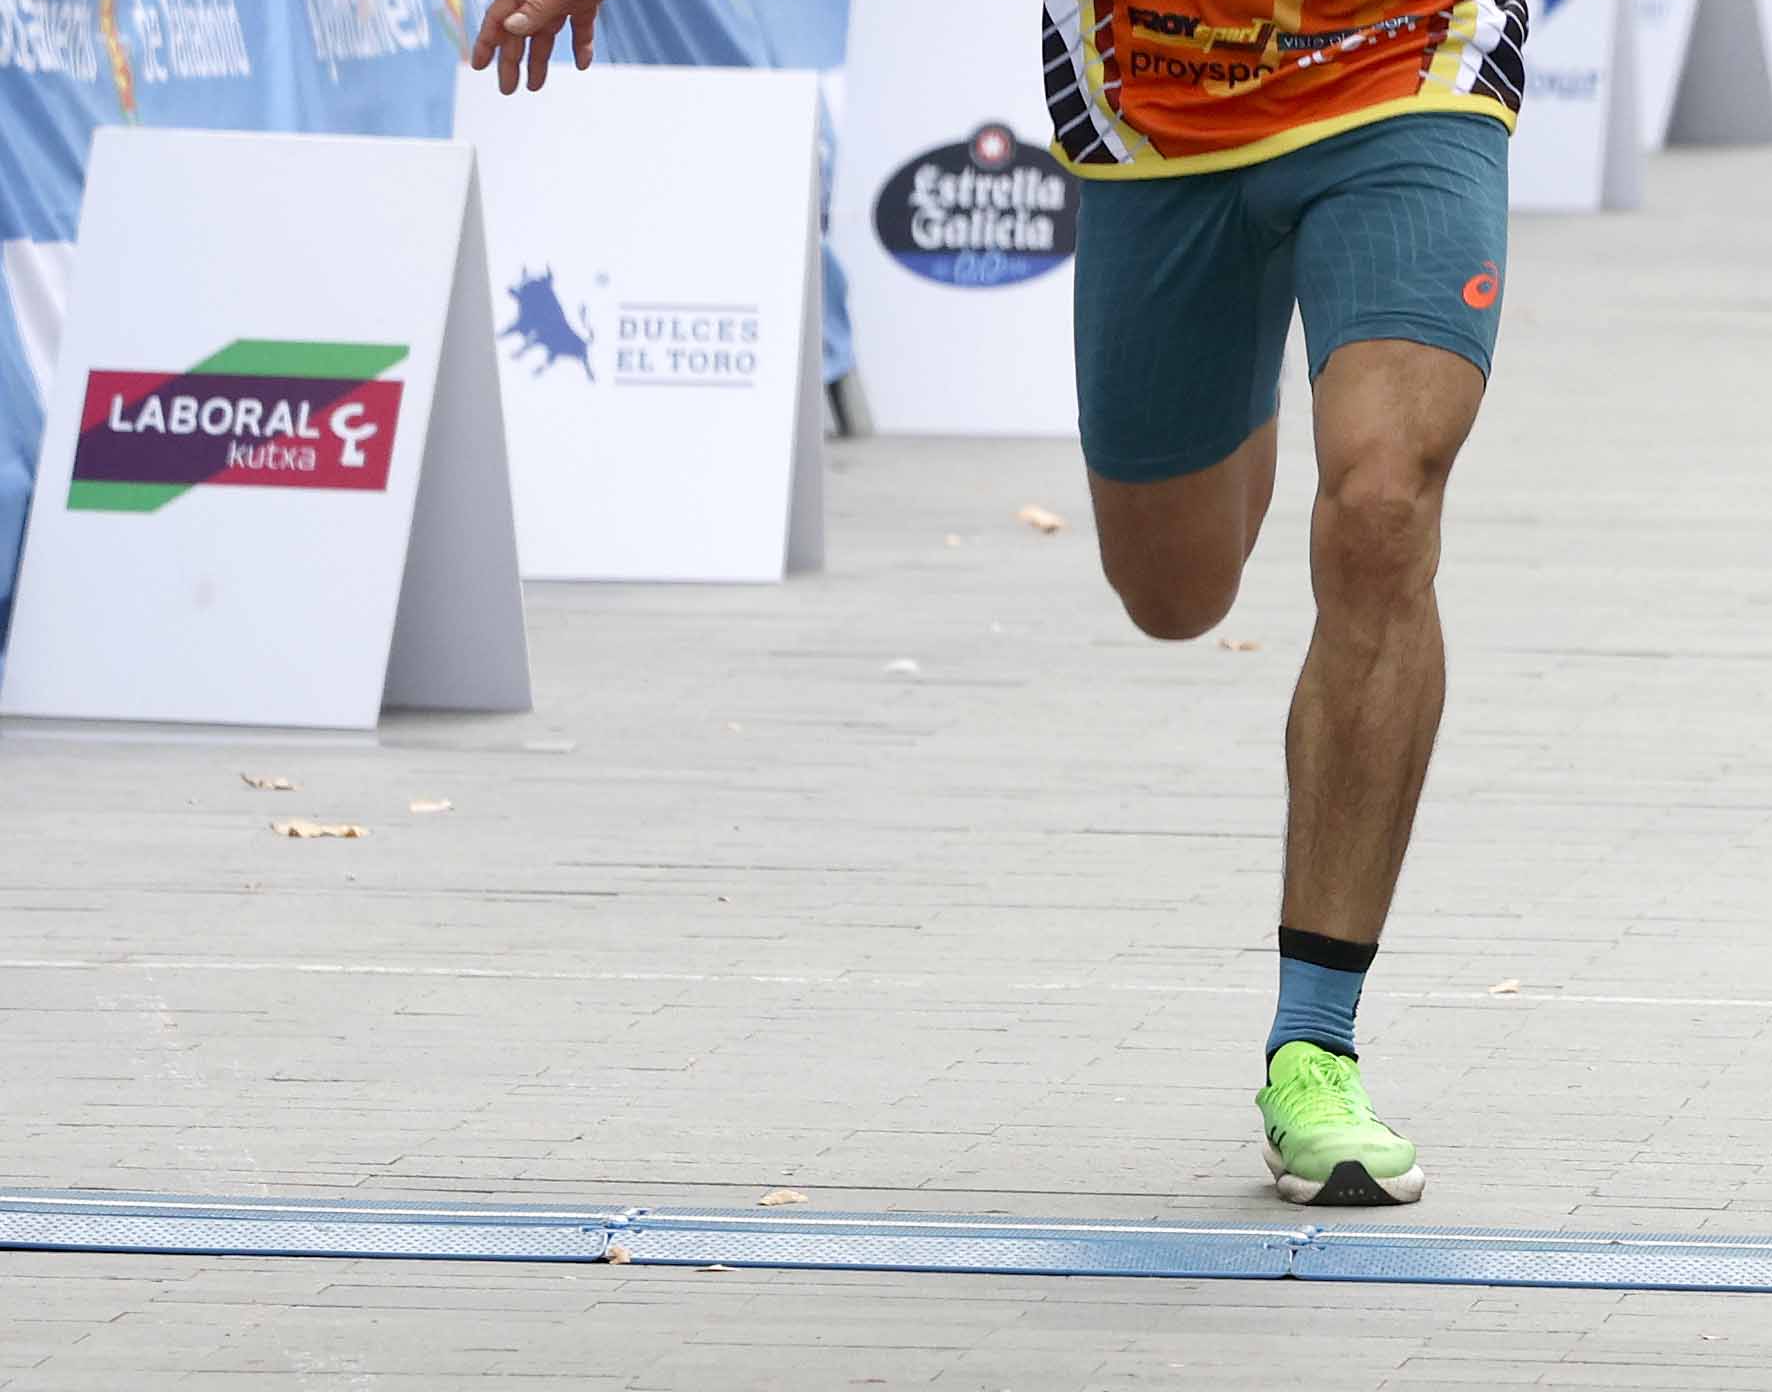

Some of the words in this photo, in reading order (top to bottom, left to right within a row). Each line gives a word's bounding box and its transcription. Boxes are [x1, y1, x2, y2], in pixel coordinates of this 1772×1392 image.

[909, 164, 1066, 211] Estrella
[911, 207, 1054, 250] Galicia
[618, 317, 760, 343] DULCES
[616, 348, 654, 372] EL
[666, 348, 756, 374] TORO
[108, 394, 320, 438] LABORAL
[225, 439, 317, 471] kutxa
